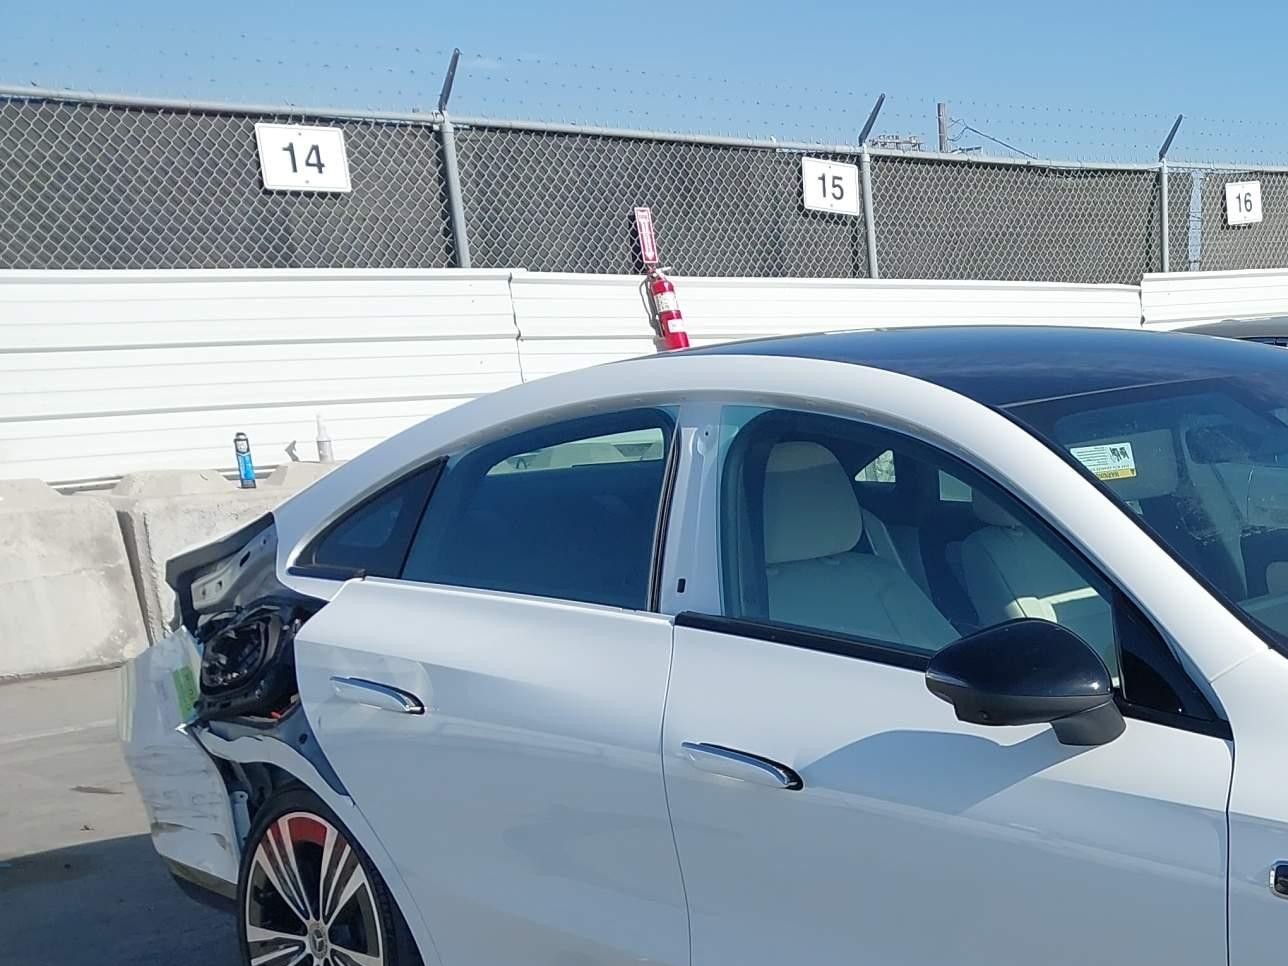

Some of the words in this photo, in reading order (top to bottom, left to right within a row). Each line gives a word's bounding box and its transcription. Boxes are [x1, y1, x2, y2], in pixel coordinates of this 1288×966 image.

[283, 142, 325, 174] 14
[818, 173, 844, 200] 15
[1236, 192, 1254, 213] 16
